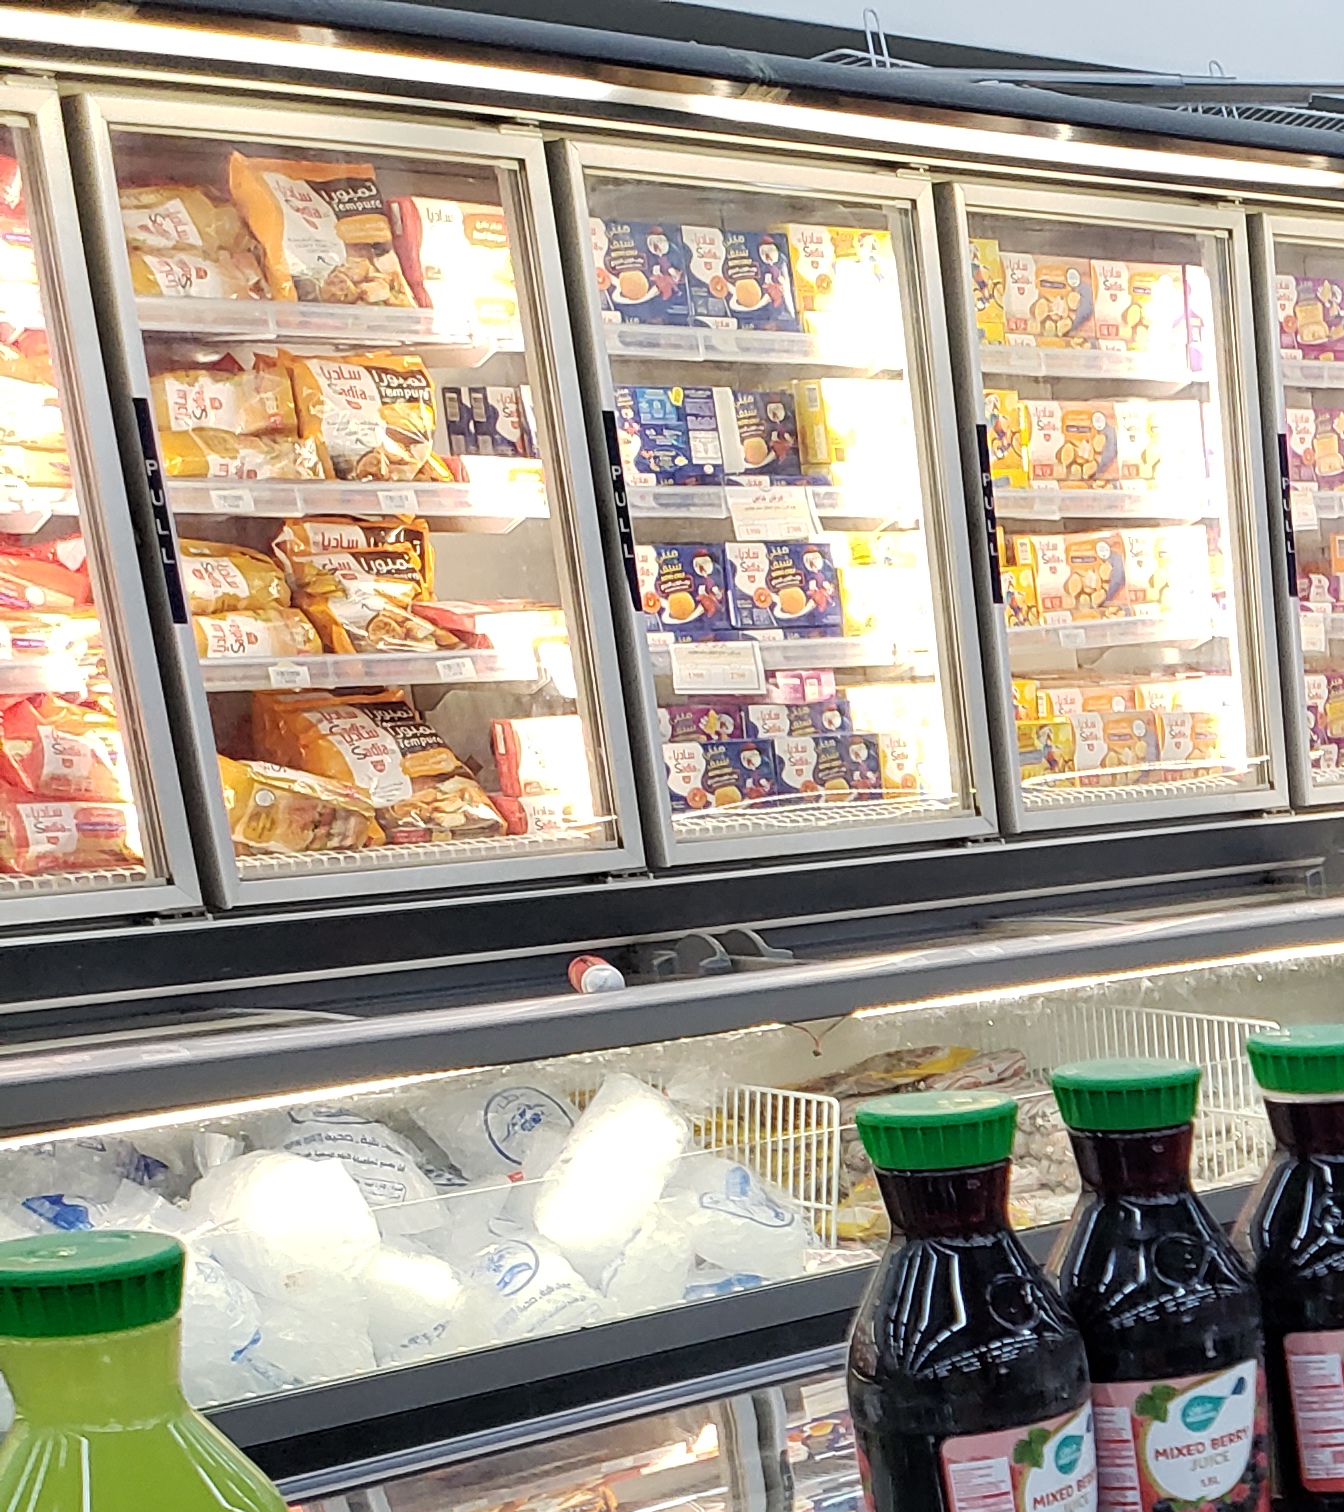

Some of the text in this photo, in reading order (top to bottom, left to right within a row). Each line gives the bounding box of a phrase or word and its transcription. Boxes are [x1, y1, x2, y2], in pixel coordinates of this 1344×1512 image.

[323, 181, 378, 204] تمبورا
[320, 364, 363, 383] ساديا
[372, 367, 428, 389] تمبورا
[145, 459, 176, 566] PULL
[611, 465, 634, 559] PULL
[350, 743, 389, 761] Sadia
[1154, 1425, 1250, 1462] MIXED BERRY
[1189, 1451, 1231, 1472] JUICE
[1032, 1483, 1074, 1511] MIXED
